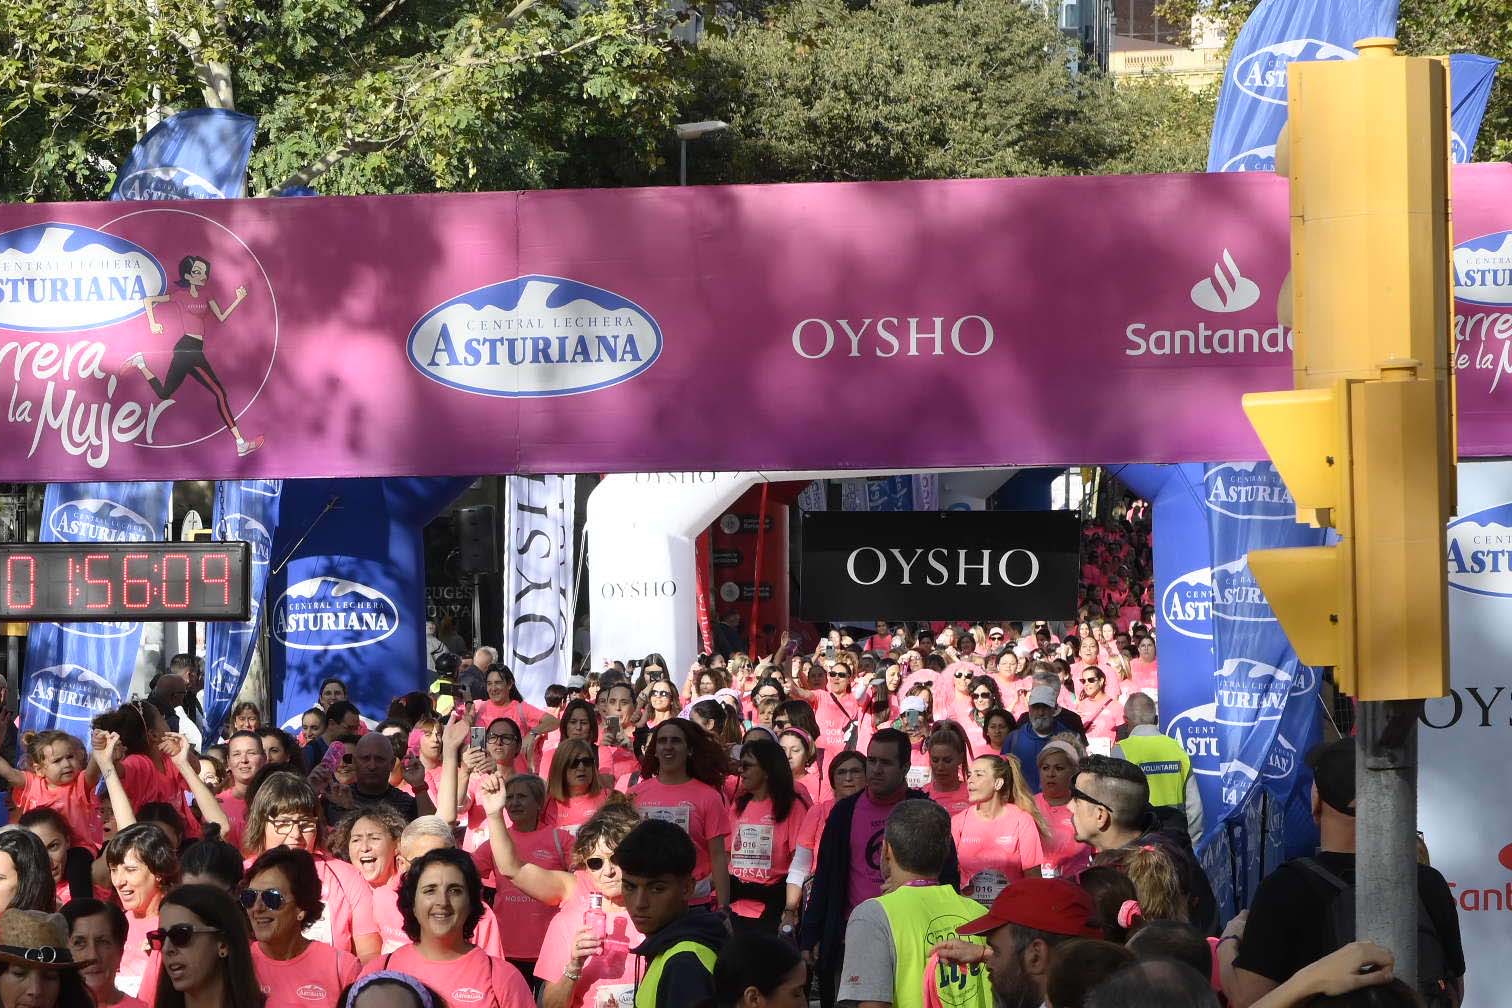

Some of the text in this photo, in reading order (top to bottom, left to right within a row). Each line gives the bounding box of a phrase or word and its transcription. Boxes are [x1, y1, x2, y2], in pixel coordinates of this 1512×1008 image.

[70, 258, 142, 270] LECHERA
[466, 316, 633, 330] CENTRAL LECHERA
[427, 322, 642, 367] ASTURIANA
[792, 314, 995, 360] OYSHO
[1476, 343, 1494, 369] la
[8, 383, 32, 423] la
[27, 375, 176, 468] Mujer
[846, 546, 1040, 588] OYSHO
[601, 580, 677, 599] OYSHO
[289, 601, 384, 610] CENTRAL LECHERA
[276, 606, 390, 634] ASTURIANA
